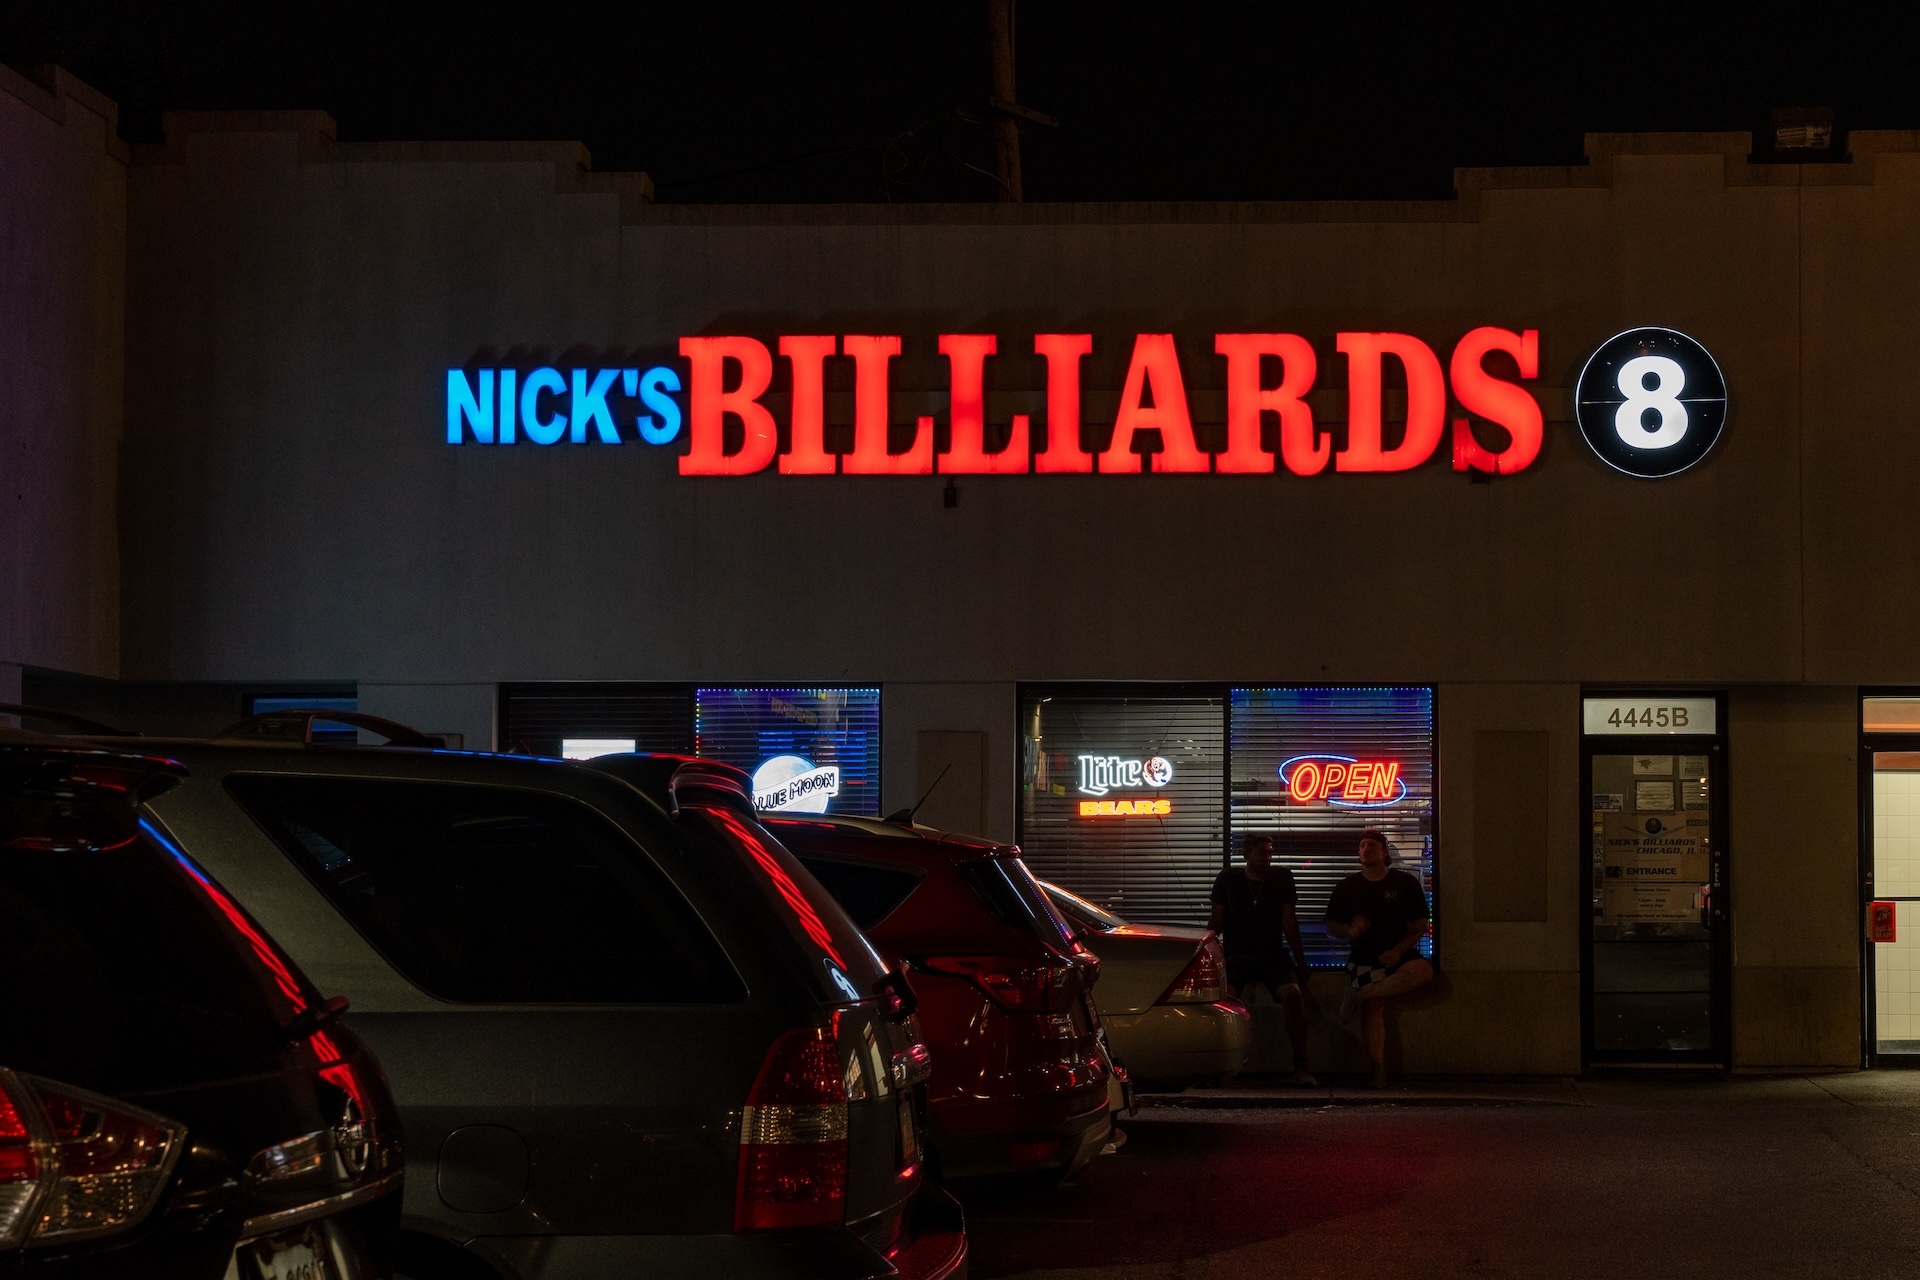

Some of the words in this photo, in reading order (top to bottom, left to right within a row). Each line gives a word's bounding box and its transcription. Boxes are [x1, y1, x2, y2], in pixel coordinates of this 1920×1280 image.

[445, 365, 683, 446] NICK'S
[677, 325, 1545, 478] BILLIARDS
[1614, 354, 1690, 450] 8
[1607, 707, 1689, 728] 4445B
[751, 788, 787, 811] LUE
[789, 772, 835, 801] MOON
[1290, 762, 1399, 801] OPEN
[1079, 799, 1172, 816] BEARS
[1607, 838, 1640, 846] NICK'S
[1643, 838, 1696, 846] BILLIARDS
[1636, 847, 1683, 855] CHICAGO,
[1687, 847, 1696, 855] IL
[1626, 867, 1677, 875] ENTRANCE
